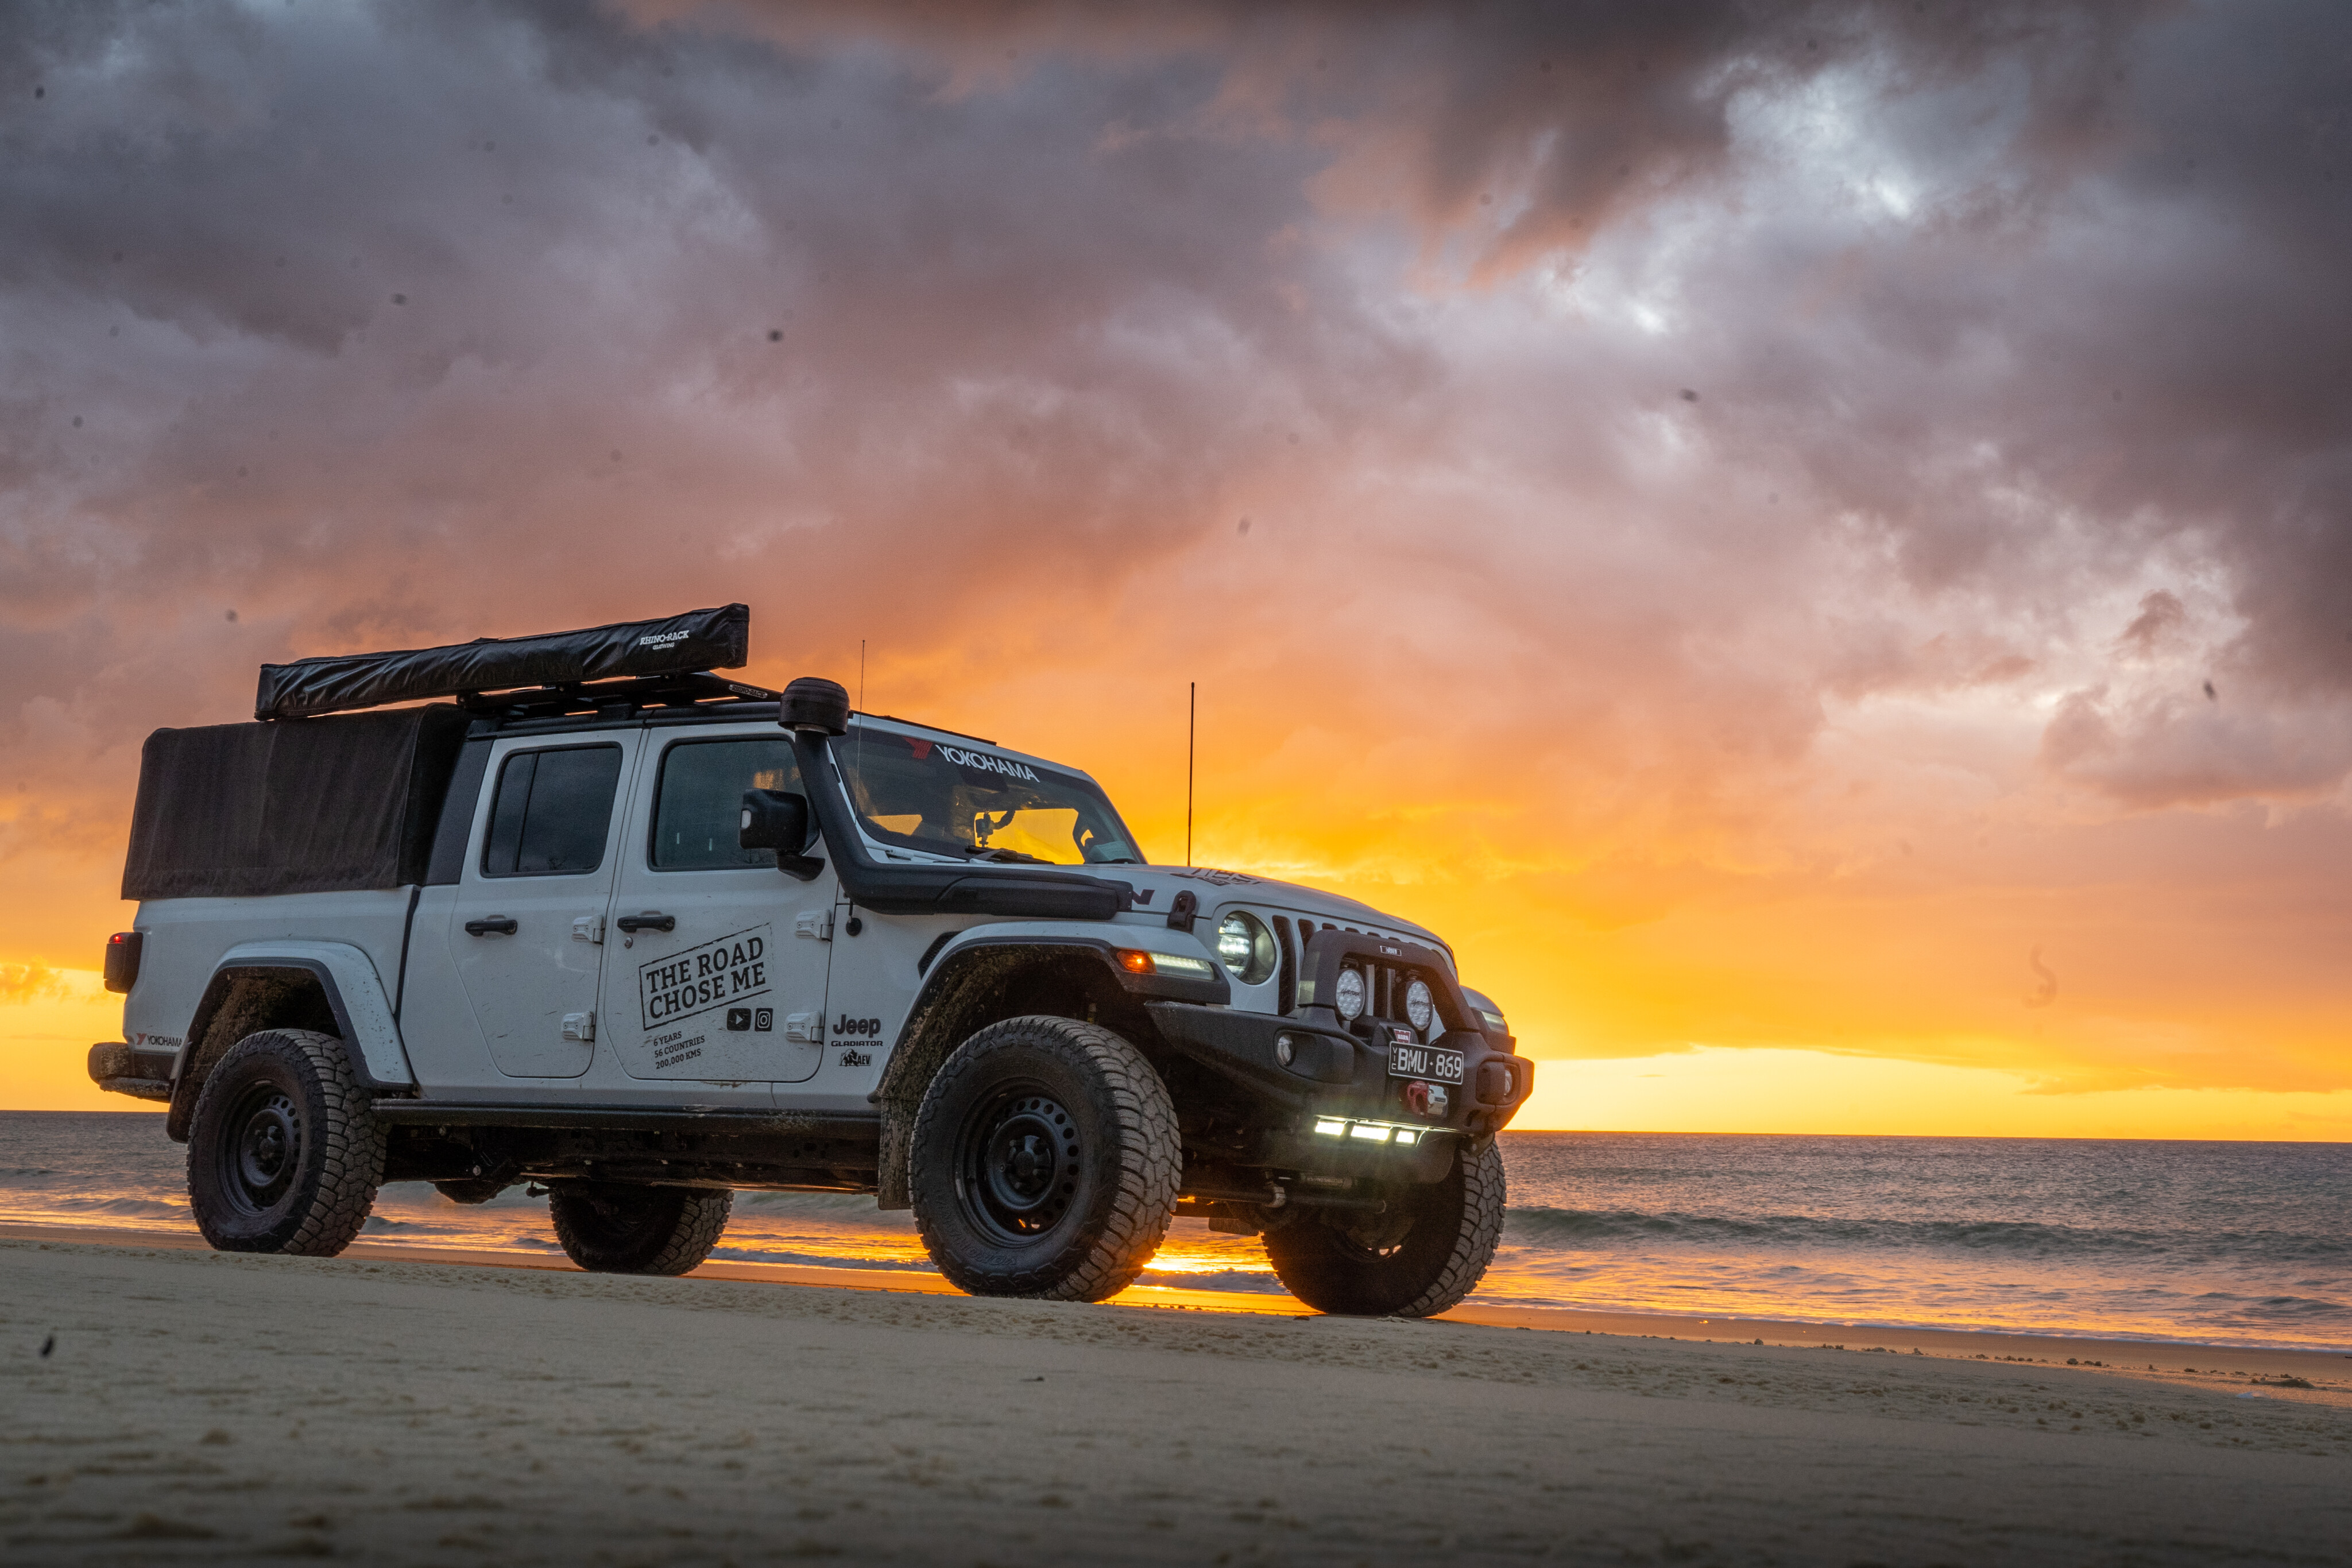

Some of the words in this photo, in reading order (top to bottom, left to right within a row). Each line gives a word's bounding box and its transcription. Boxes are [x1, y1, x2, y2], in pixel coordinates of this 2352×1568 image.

[640, 630, 689, 645] RHINO-RACK
[732, 684, 765, 698] RHINO-RACK
[935, 744, 1040, 783] YOKOHAMA
[646, 959, 691, 994] THE
[697, 937, 763, 978] ROAD
[649, 974, 725, 1019] CHOSE
[730, 962, 765, 994] ME
[833, 1014, 881, 1038] Jeep
[147, 1035, 182, 1047] YOKOHAMA
[655, 1048, 663, 1058] 56
[664, 1035, 705, 1054] COUNTRIES
[659, 1031, 682, 1044] YEARS
[656, 1054, 684, 1070] 200,000
[686, 1048, 701, 1060] KMS
[857, 1055, 871, 1064] AEV
[1398, 1048, 1428, 1074] BMU
[1436, 1054, 1462, 1078] 869
